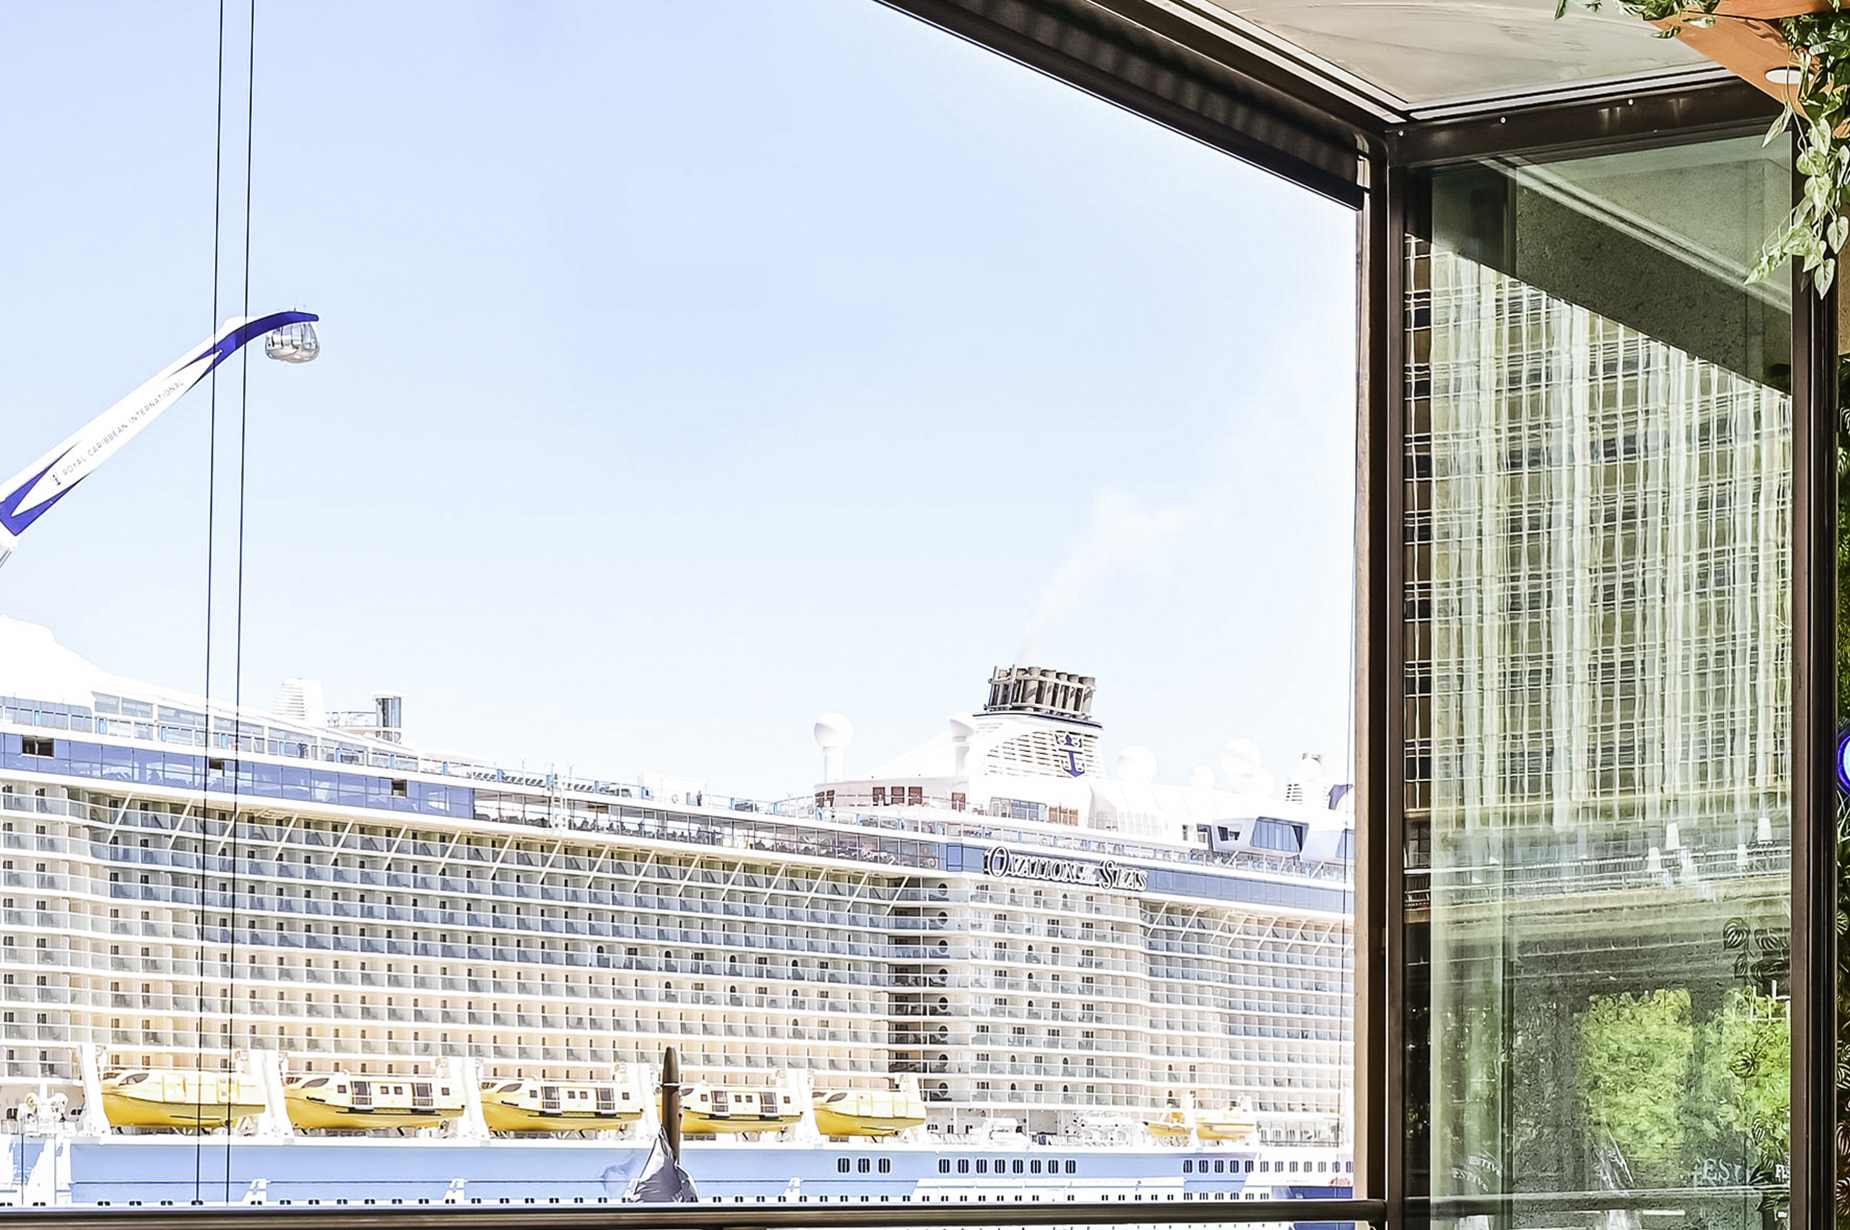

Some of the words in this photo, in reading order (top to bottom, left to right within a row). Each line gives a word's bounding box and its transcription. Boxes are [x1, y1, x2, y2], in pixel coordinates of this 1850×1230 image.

[62, 456, 86, 475] ROYAL
[87, 423, 128, 457] CARIBBEAN
[128, 381, 184, 425] INTERNATIONAL
